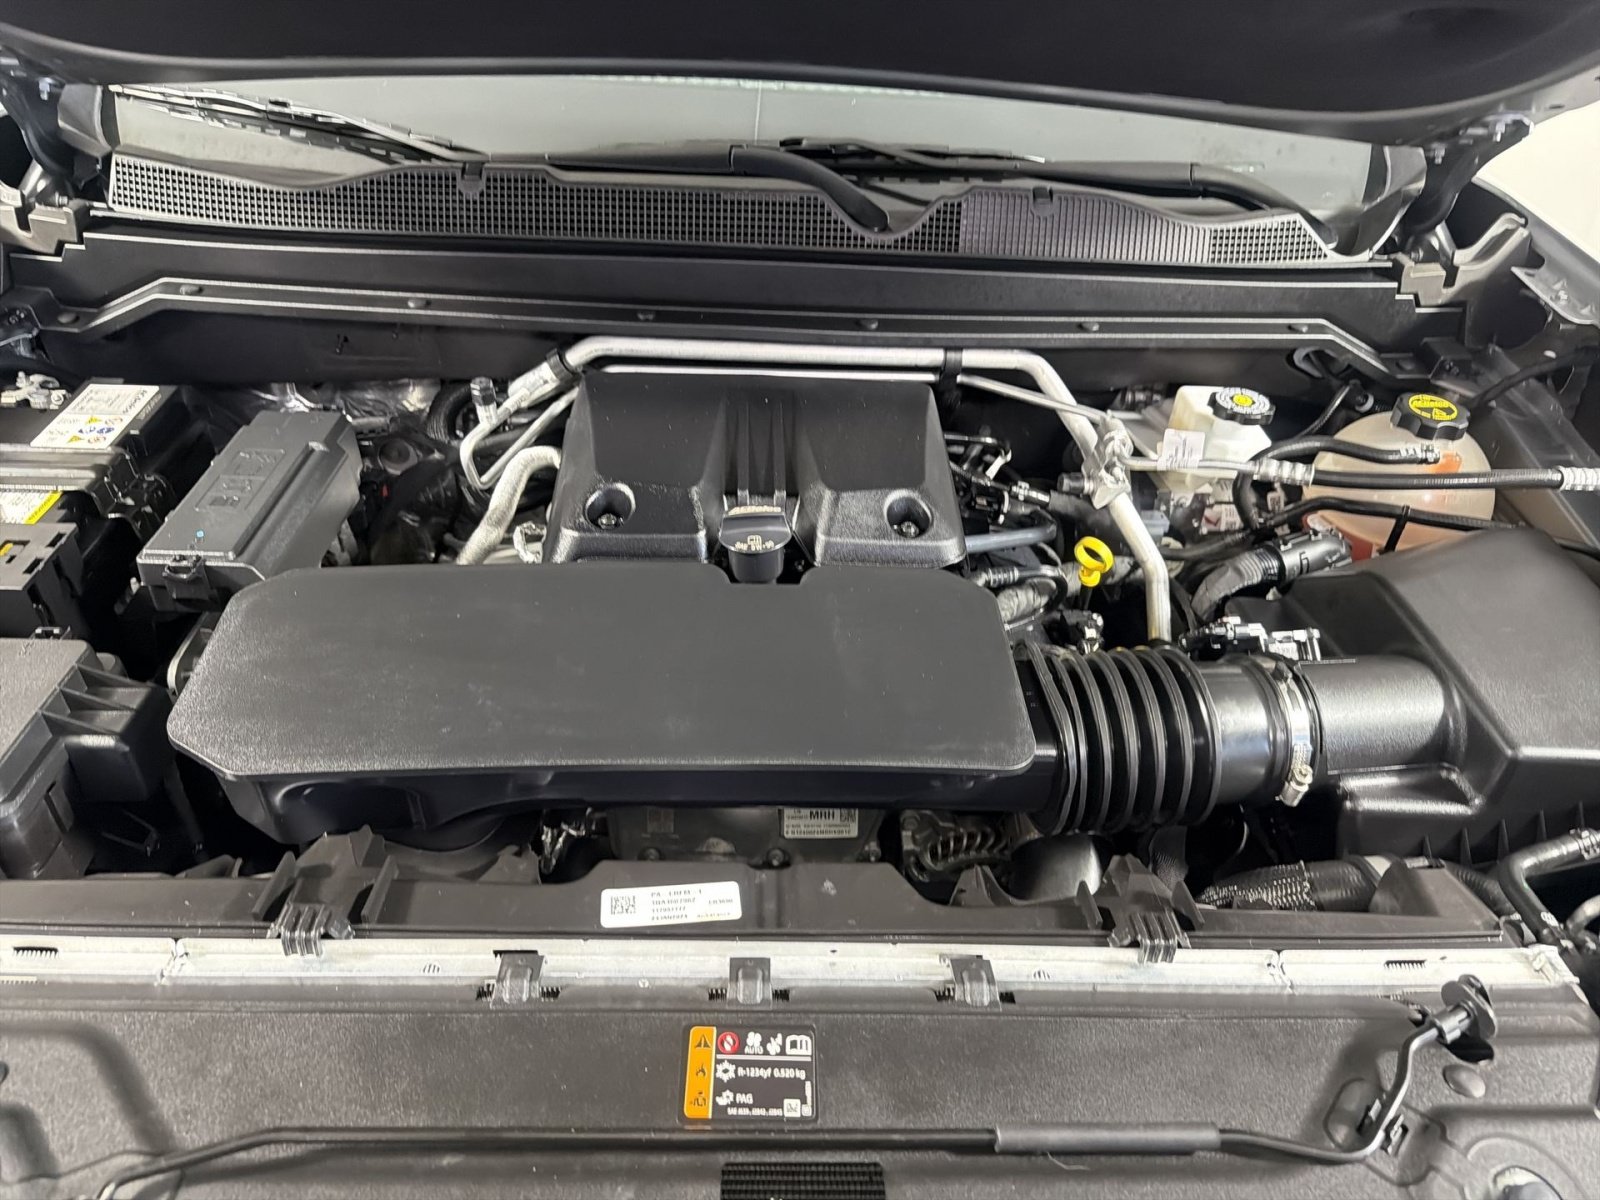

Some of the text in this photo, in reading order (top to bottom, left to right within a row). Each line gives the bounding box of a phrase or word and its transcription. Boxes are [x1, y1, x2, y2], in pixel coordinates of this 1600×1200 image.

[744, 1047, 764, 1055] AUTO
[737, 1066, 806, 1080] R-1234yf 0.520 kg
[735, 1093, 754, 1105] PAG
